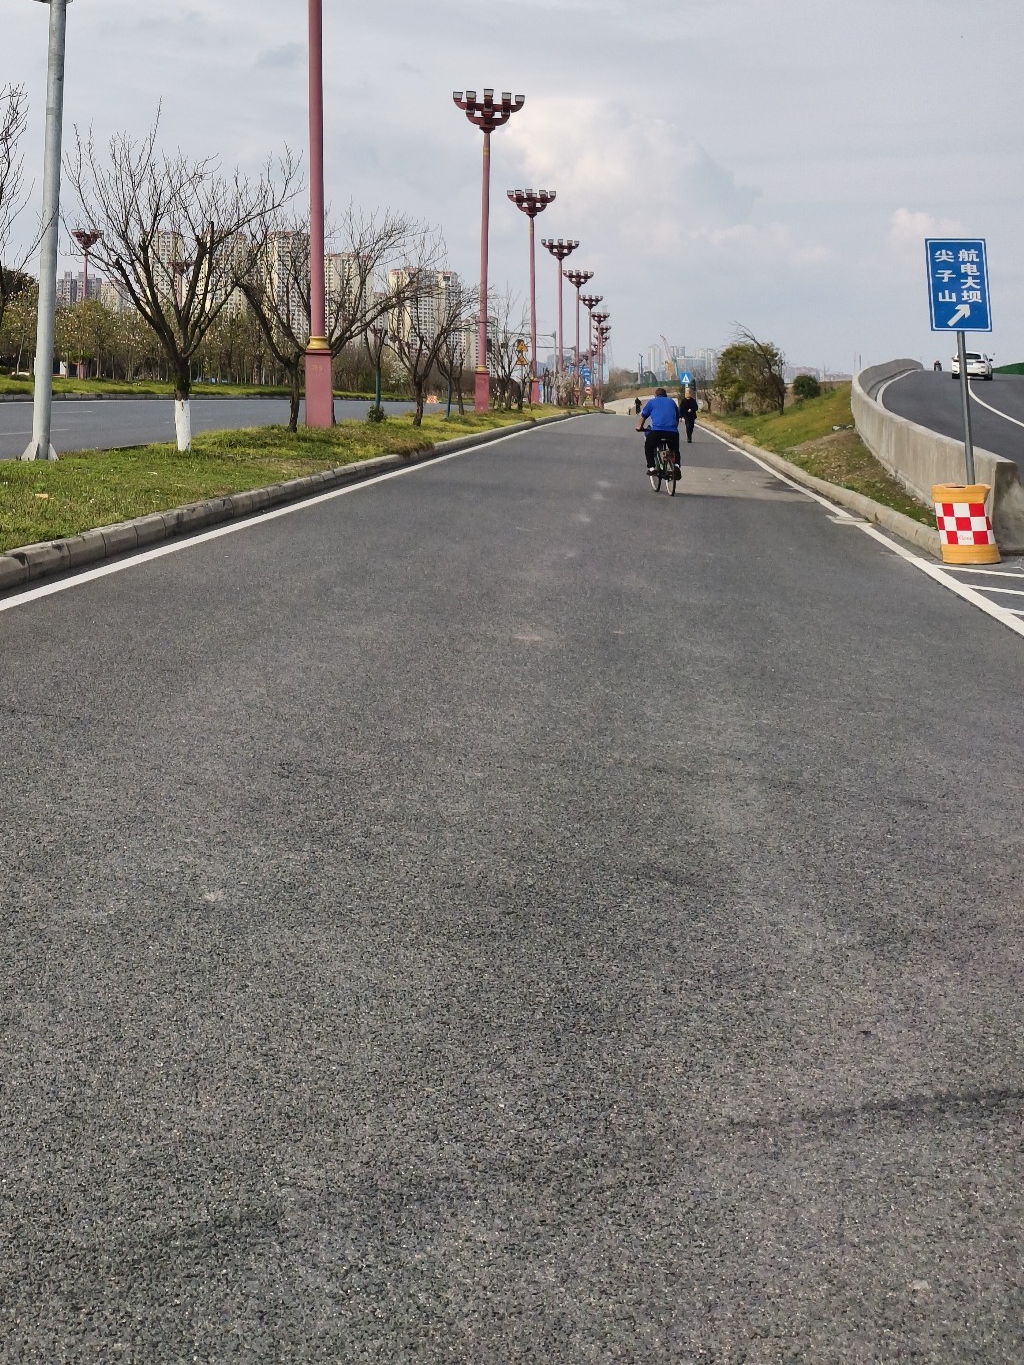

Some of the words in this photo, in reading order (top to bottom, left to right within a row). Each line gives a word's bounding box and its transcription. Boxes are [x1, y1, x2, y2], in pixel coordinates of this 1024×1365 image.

[934, 249, 957, 302] 尖子山
[958, 248, 983, 303] 航电大坝
